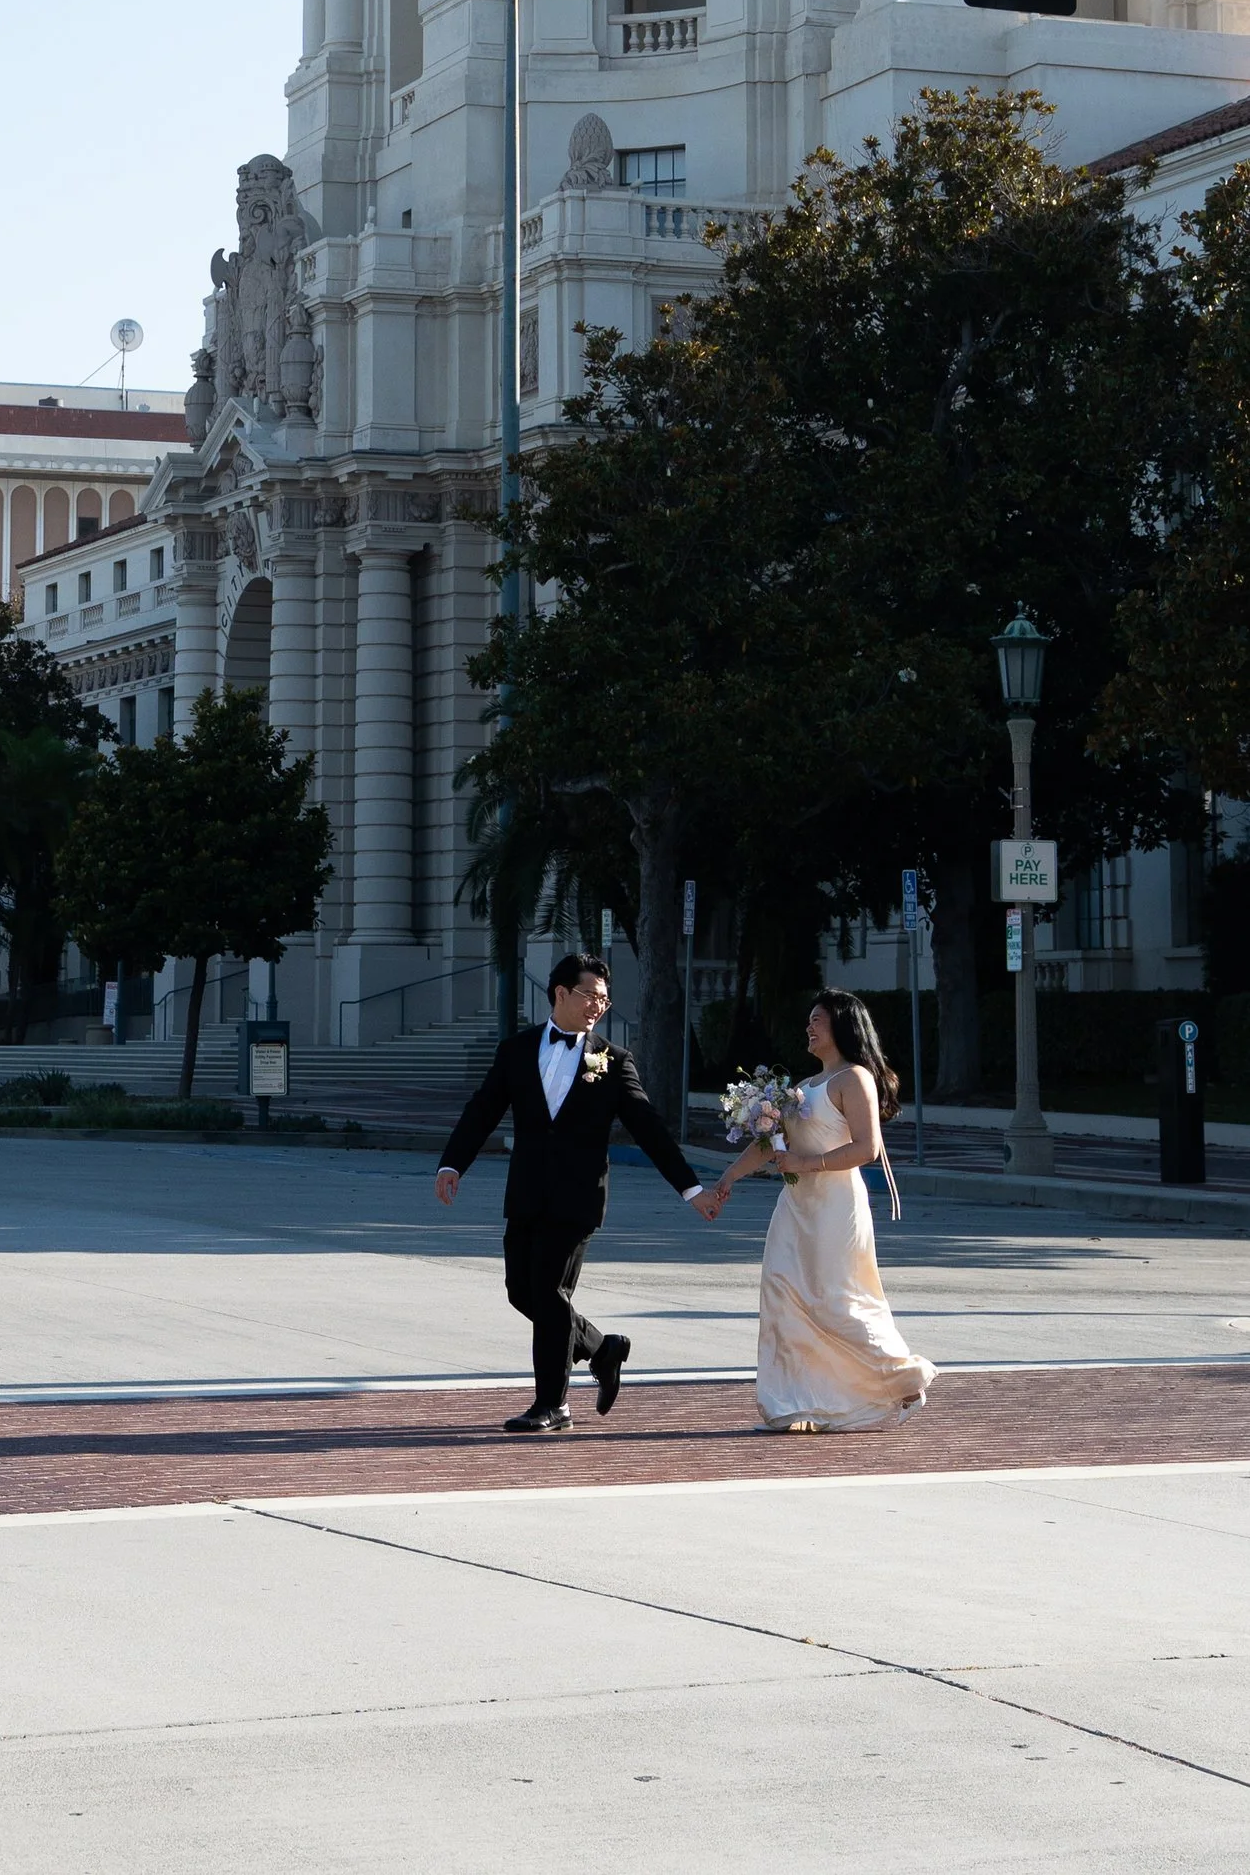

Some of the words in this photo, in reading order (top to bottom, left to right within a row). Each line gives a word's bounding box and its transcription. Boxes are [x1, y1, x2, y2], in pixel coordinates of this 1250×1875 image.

[221, 561, 244, 628] CITY
[1024, 846, 1032, 856] P
[1015, 859, 1041, 872] PAY
[1009, 872, 1048, 886] HERE
[1185, 1024, 1194, 1039] P
